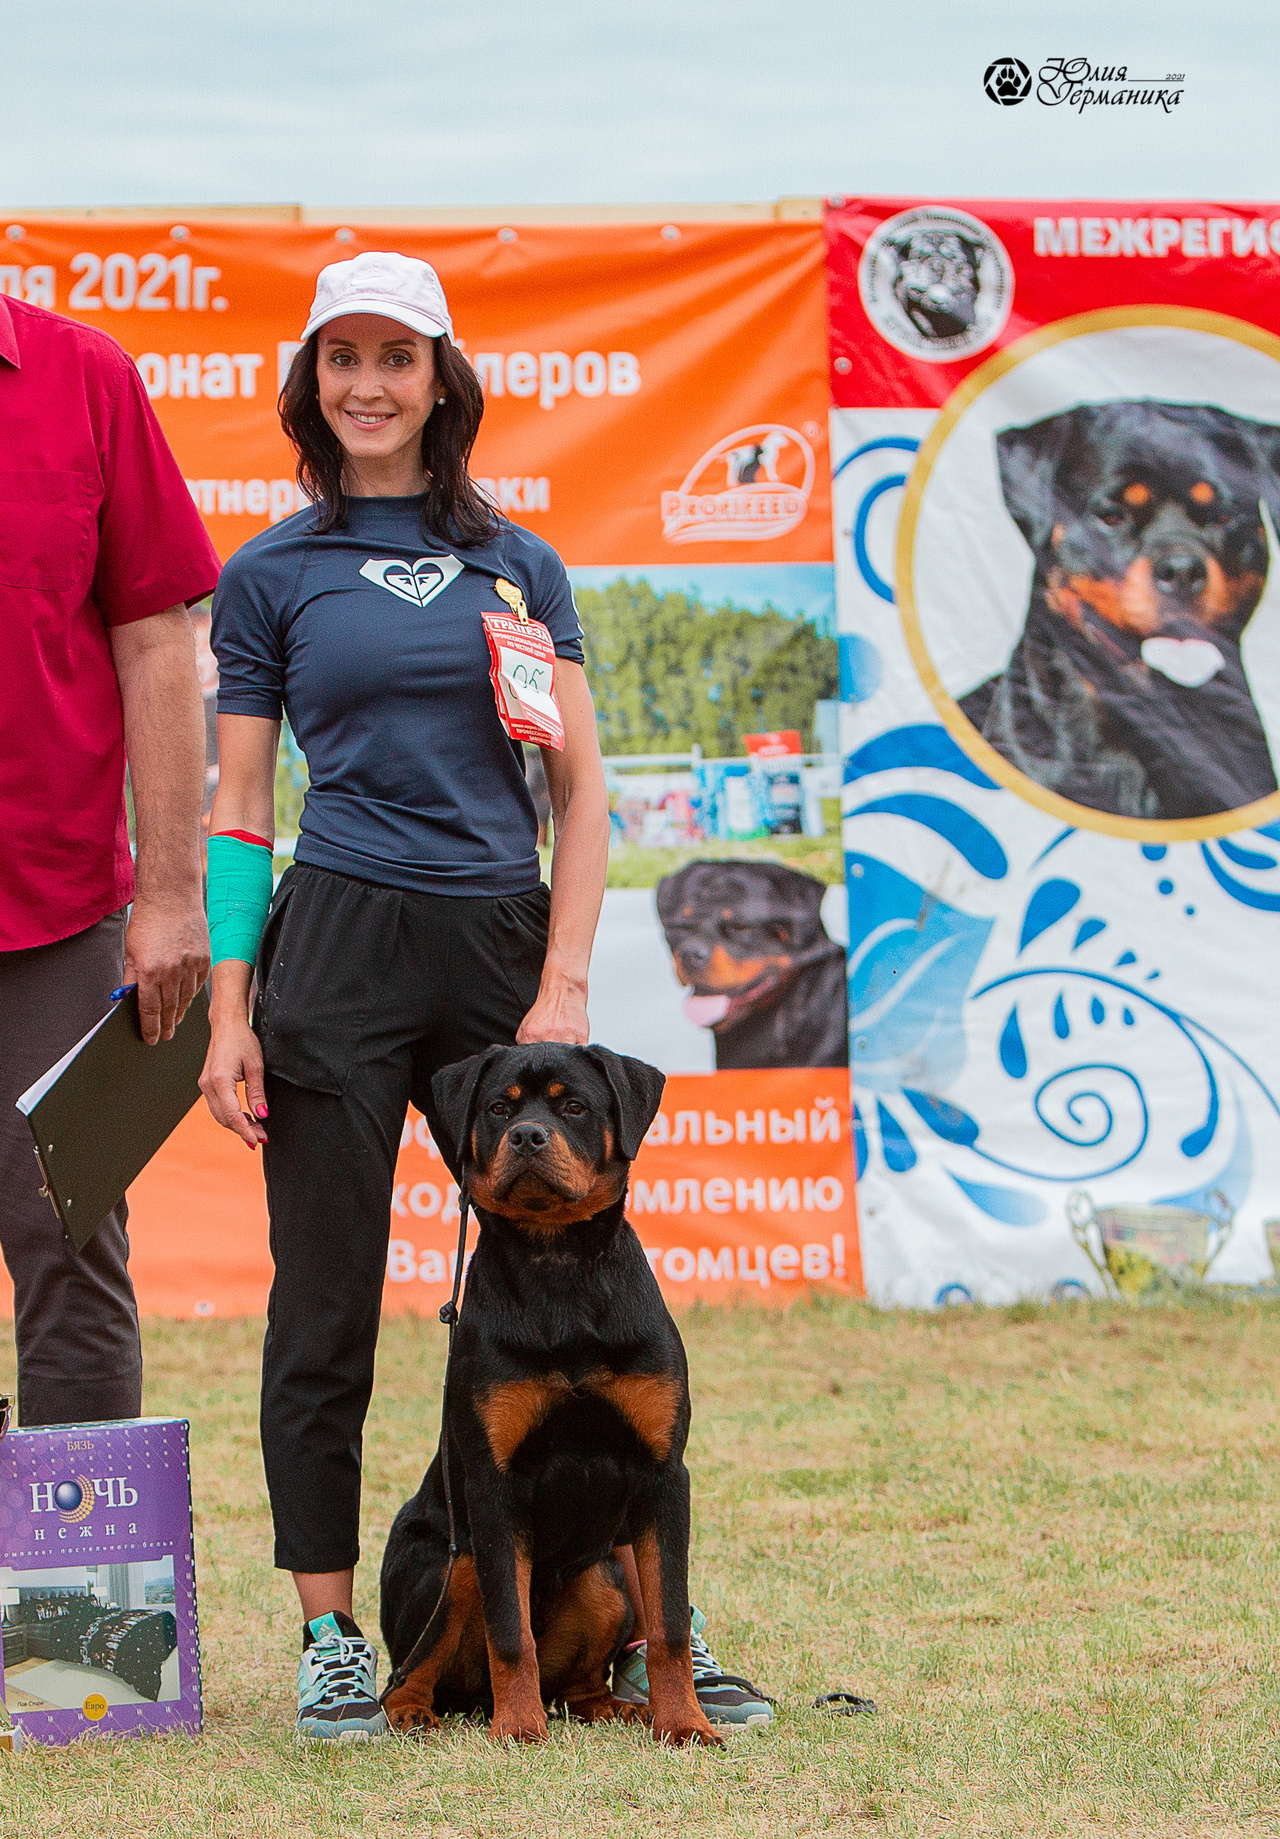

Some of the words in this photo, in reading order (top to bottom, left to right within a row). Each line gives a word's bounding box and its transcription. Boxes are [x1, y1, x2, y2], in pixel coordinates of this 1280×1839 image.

[69, 252, 230, 312] 2021г.
[133, 352, 265, 399] онат
[470, 350, 642, 411] леров
[186, 479, 310, 521] тнер
[490, 618, 550, 642] ТРАПЕЗА
[643, 1096, 841, 1147] альный
[625, 1176, 844, 1215] млению
[643, 1233, 846, 1290] омцев!
[66, 1440, 95, 1452] БЯЗЬ
[29, 1476, 139, 1514] НОЧЬ
[34, 1522, 138, 1541] нежна
[60, 1543, 136, 1555] постельного
[142, 1540, 175, 1549] белья
[84, 1701, 106, 1712] Евро
